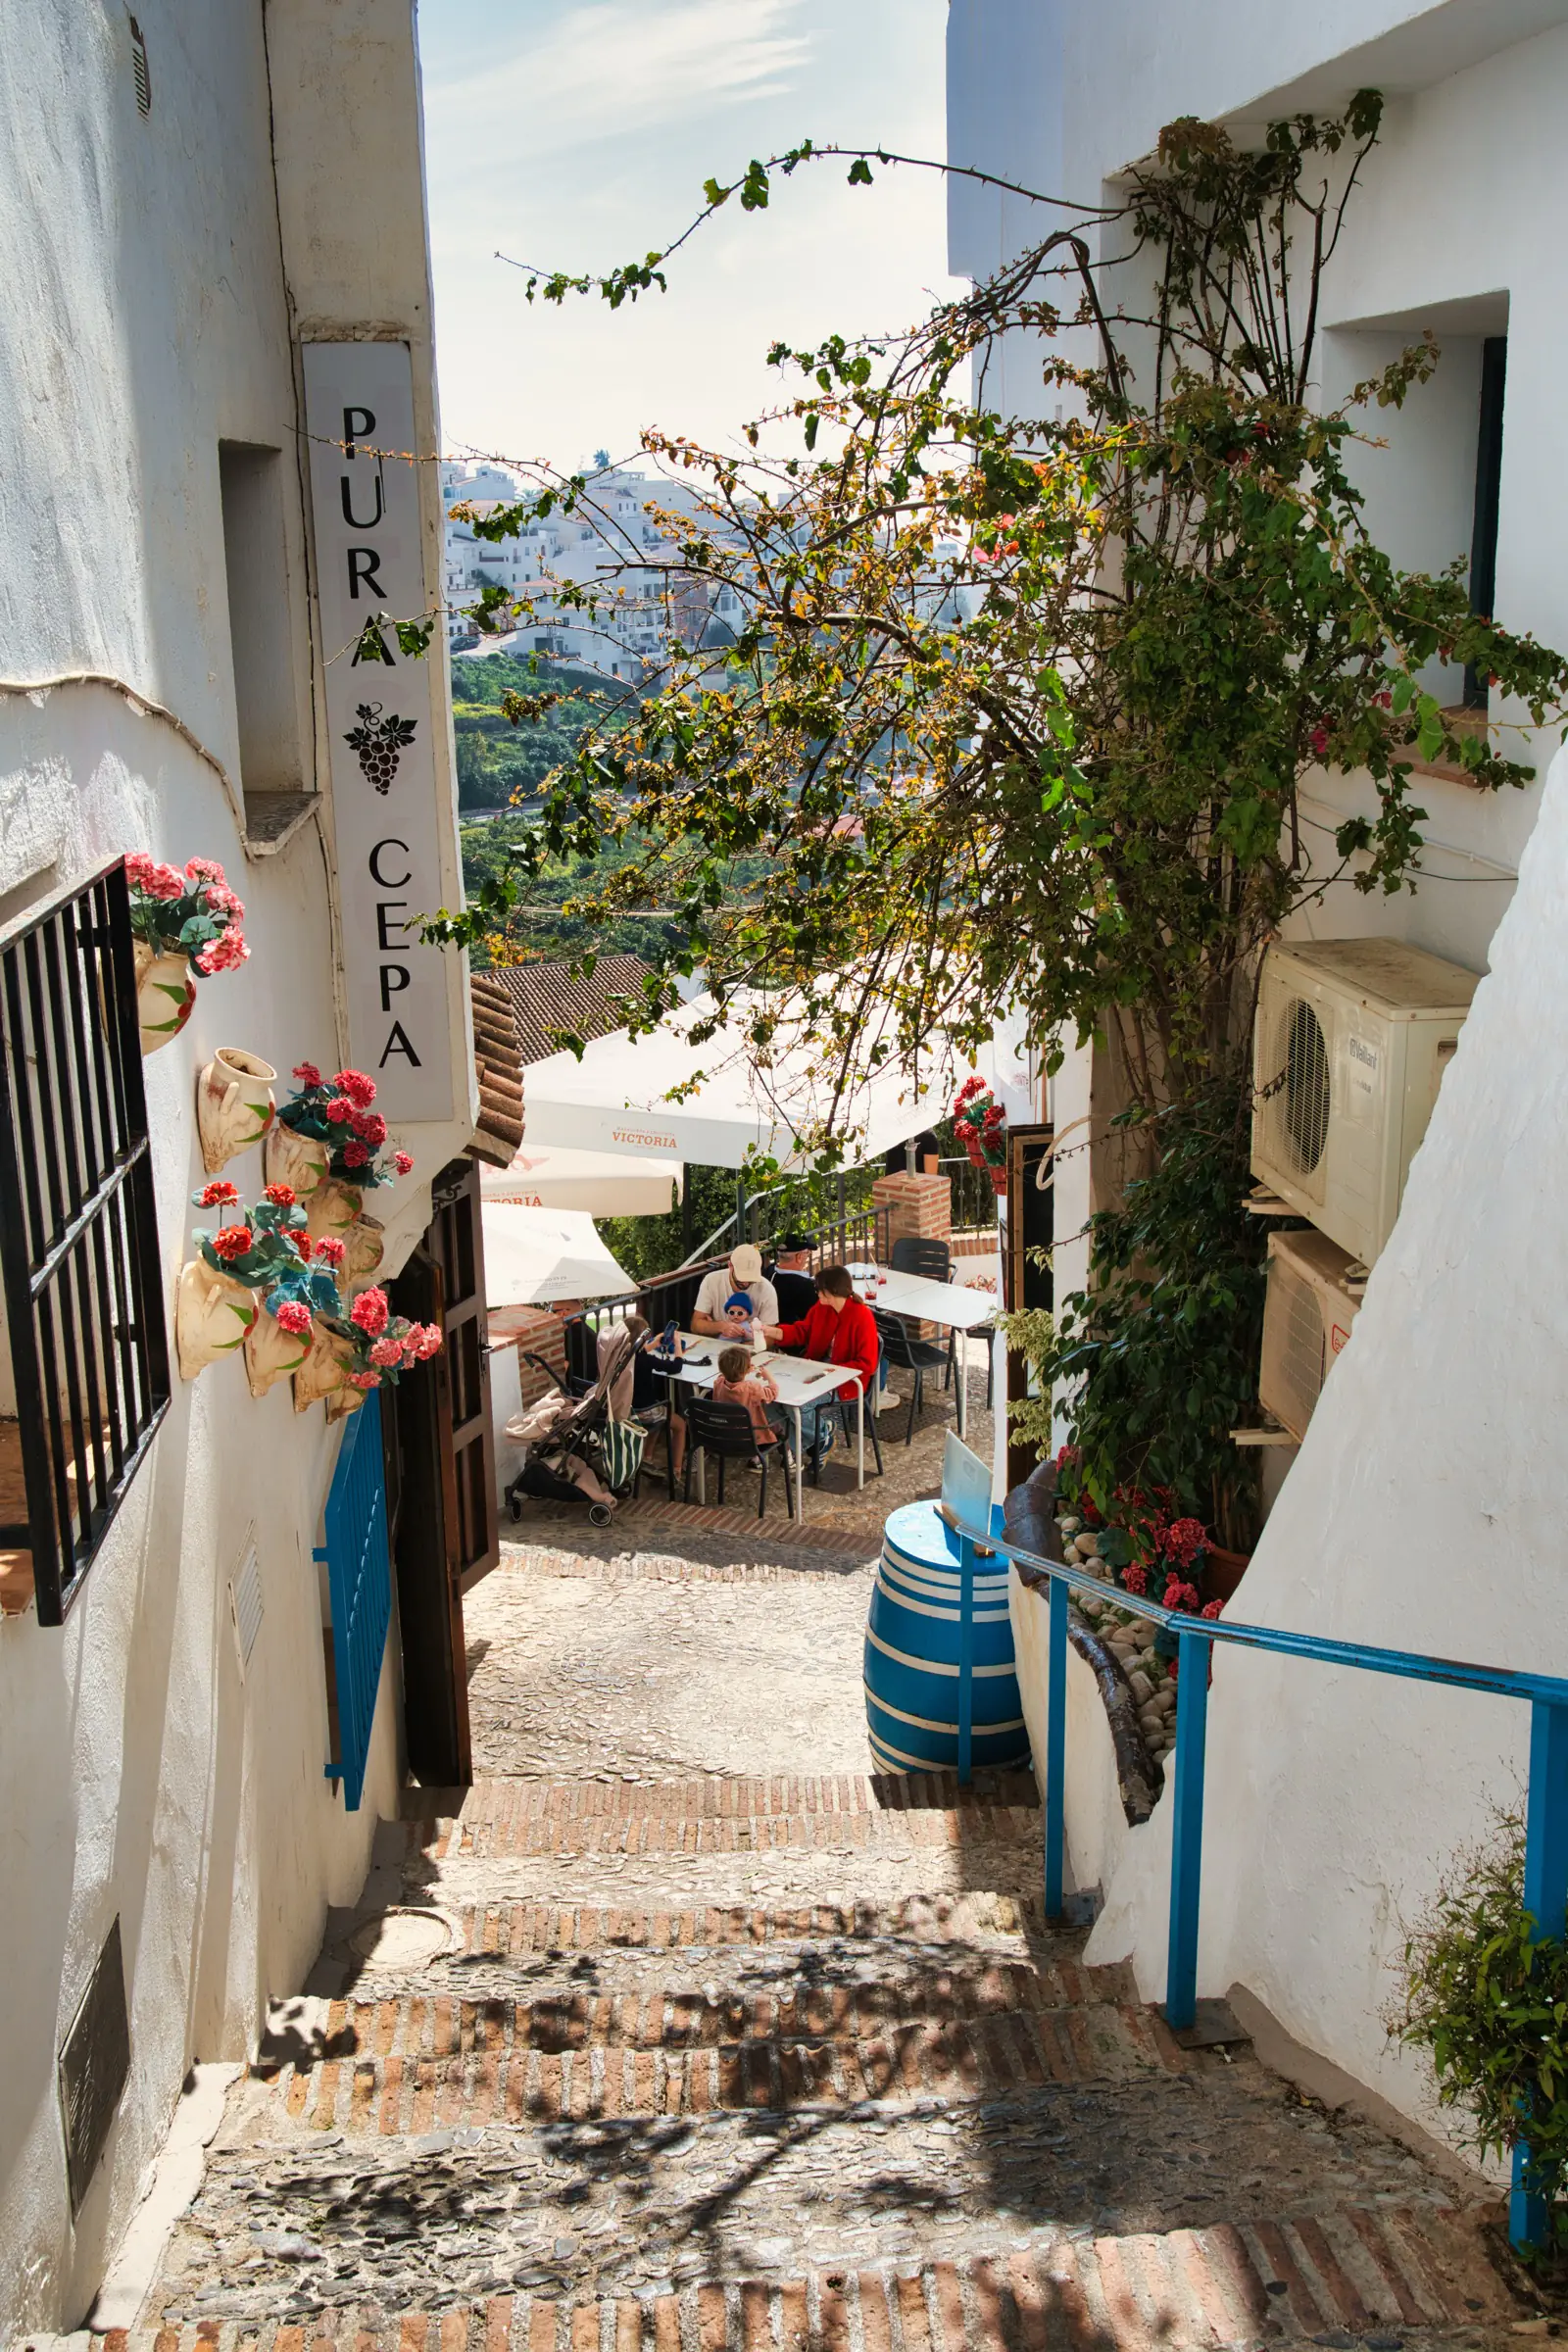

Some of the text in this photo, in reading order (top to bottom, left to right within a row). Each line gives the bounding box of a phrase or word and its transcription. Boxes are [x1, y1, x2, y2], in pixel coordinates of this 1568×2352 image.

[340, 407, 422, 1068] PURA CEPA
[612, 1131, 678, 1149] VICTORIA
